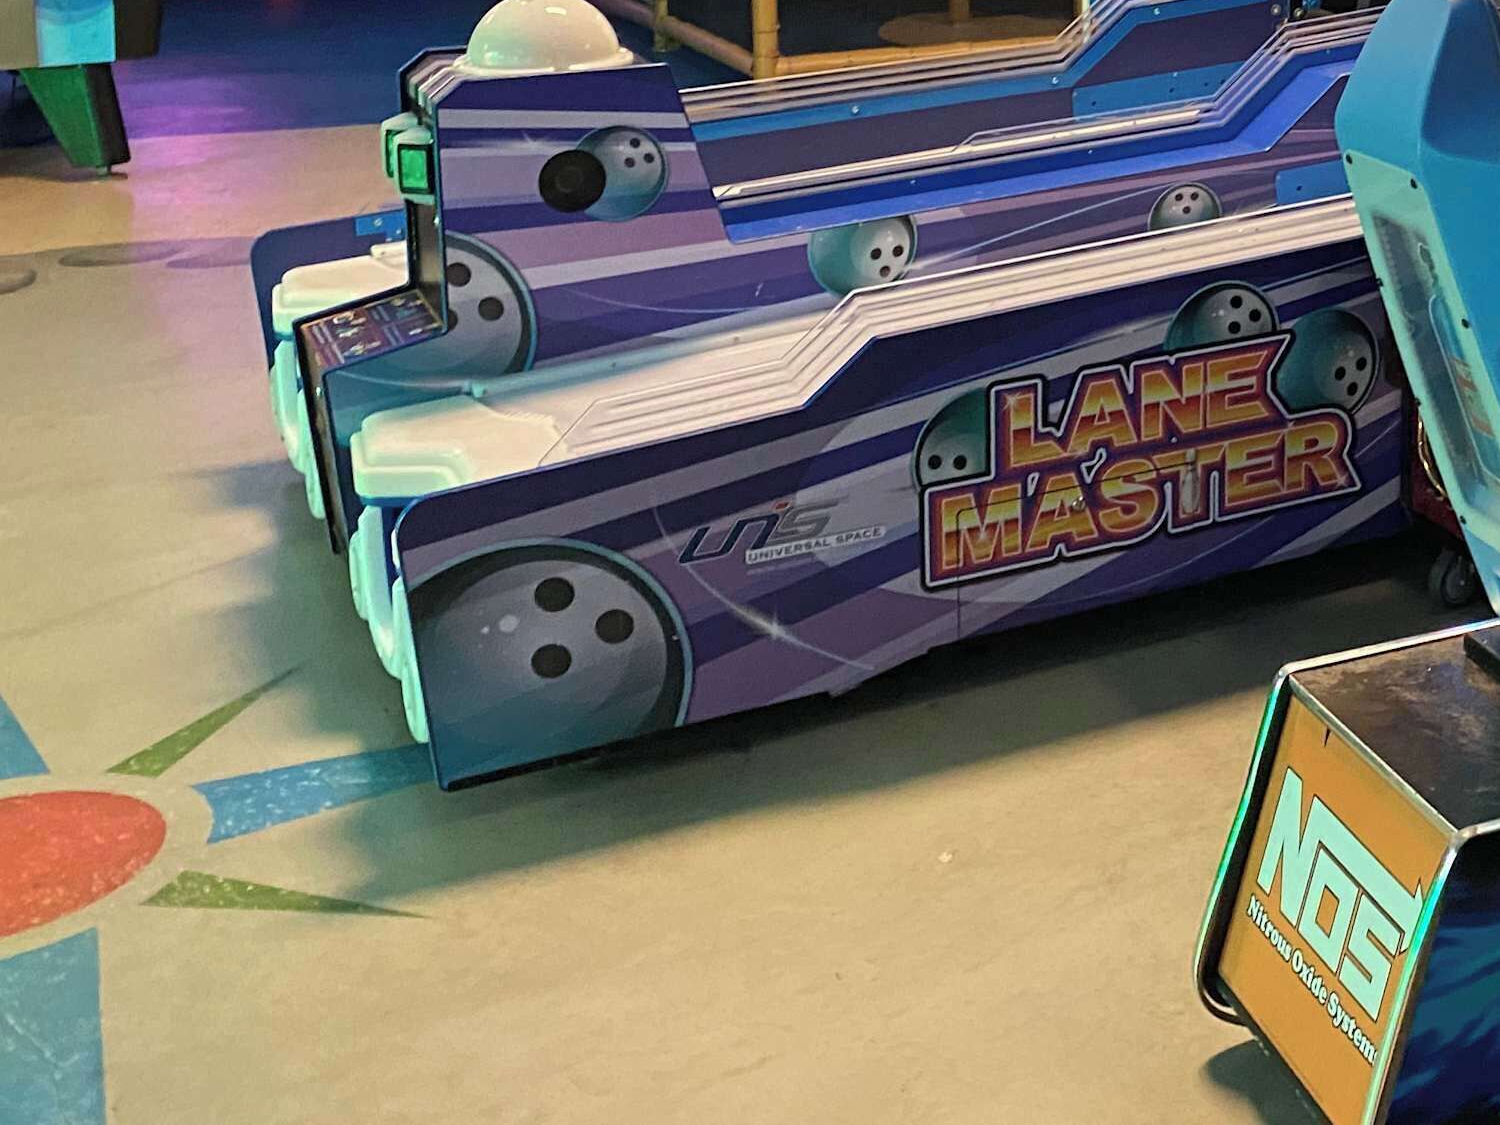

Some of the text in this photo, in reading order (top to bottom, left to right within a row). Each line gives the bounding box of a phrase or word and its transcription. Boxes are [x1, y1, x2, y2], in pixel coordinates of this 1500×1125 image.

[1007, 349, 1271, 467] LANE
[748, 527, 882, 563] UNIVERSAL SPACE
[940, 417, 1353, 574] MASTER
[1247, 895, 1292, 964] Nitrous
[1291, 948, 1328, 1006] Oxide
[1256, 766, 1425, 1023] NOS
